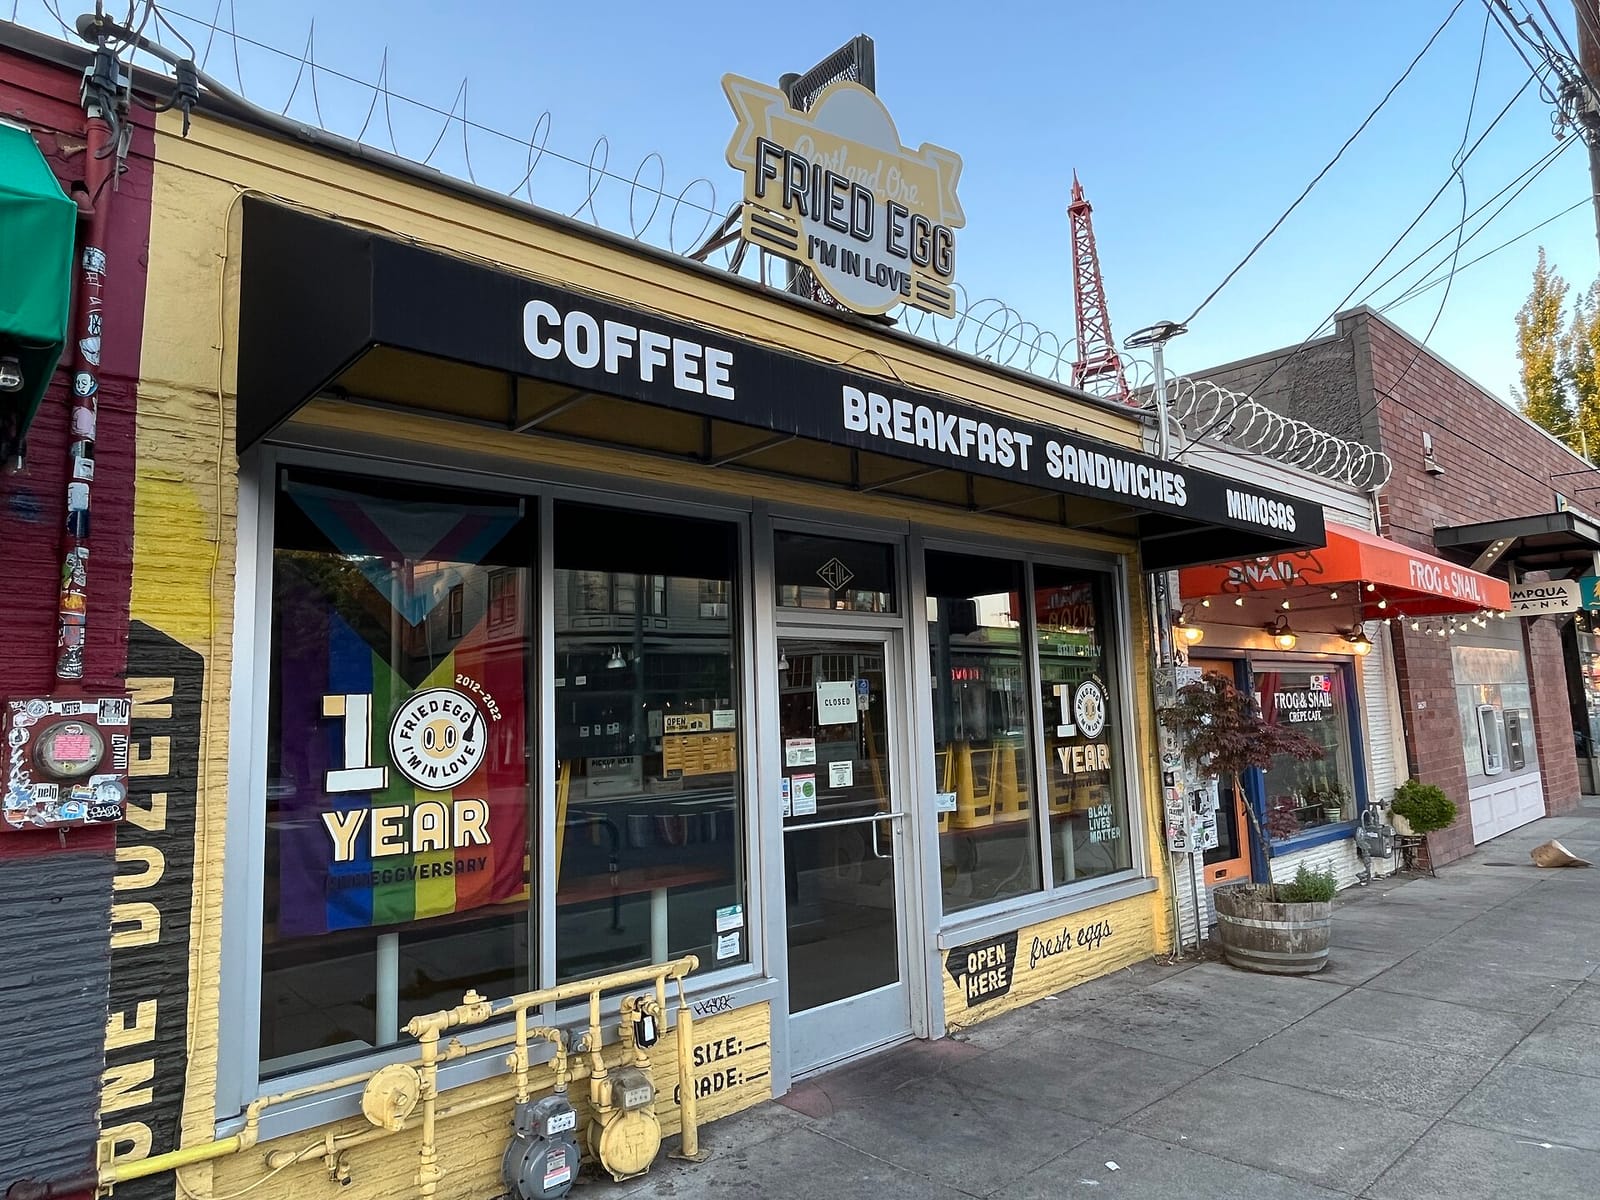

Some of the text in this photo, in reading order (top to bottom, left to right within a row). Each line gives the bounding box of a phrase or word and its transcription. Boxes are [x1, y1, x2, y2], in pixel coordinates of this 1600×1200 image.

[886, 165, 925, 206] Ore.
[755, 136, 953, 277] FRIED EGG
[808, 235, 911, 296] I'M IN LOVE
[523, 299, 735, 401] COFFEE
[841, 385, 1187, 507] BREAKFAST SANDWICHES
[1226, 489, 1296, 532] MIMOSAS
[1409, 560, 1480, 601] FROG & SNAIL
[99, 700, 128, 718] HRO
[455, 673, 502, 722] 2012-2022
[824, 697, 851, 707] CLOSED
[1274, 692, 1299, 709] FROG
[1300, 692, 1307, 708] &
[1308, 692, 1332, 708] SNAIL
[400, 699, 471, 739] FRIED EGG
[667, 716, 686, 726] OPEN
[402, 745, 475, 778] I'M IN LOVE
[1057, 744, 1111, 774] YEAR
[1088, 804, 1113, 818] BLACK
[1089, 817, 1111, 830] LIVES
[321, 799, 491, 862] YEAR
[1090, 827, 1120, 843] MATTER
[967, 943, 1006, 973] OPEN
[1030, 920, 1113, 970] fresh eggs
[968, 966, 1007, 999] HERE
[693, 1037, 742, 1067] SIZE:
[100, 999, 157, 1166] ONE
[674, 1068, 743, 1105] ADE:
